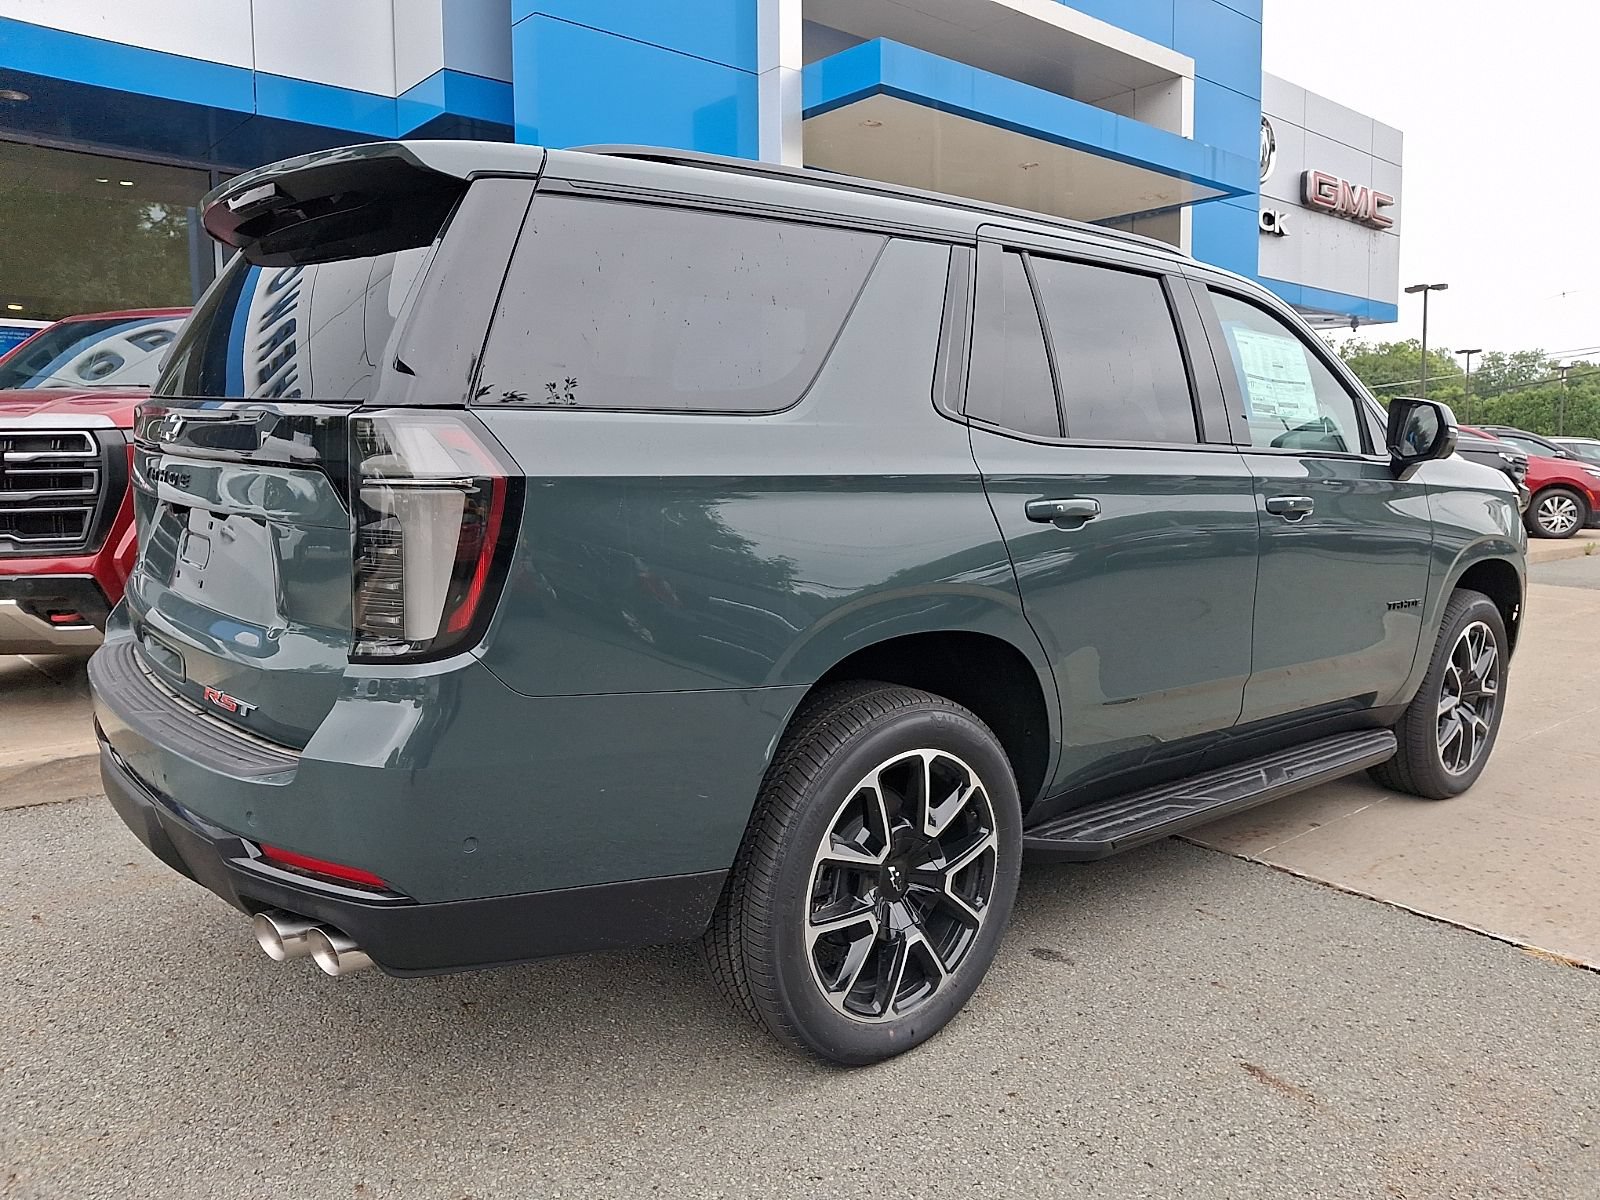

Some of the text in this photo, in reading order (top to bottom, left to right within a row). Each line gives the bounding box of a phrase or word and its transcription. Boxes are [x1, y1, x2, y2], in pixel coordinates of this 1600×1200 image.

[1302, 169, 1395, 229] GMC
[1386, 599, 1422, 610] TAHOE
[203, 685, 259, 717] RST
